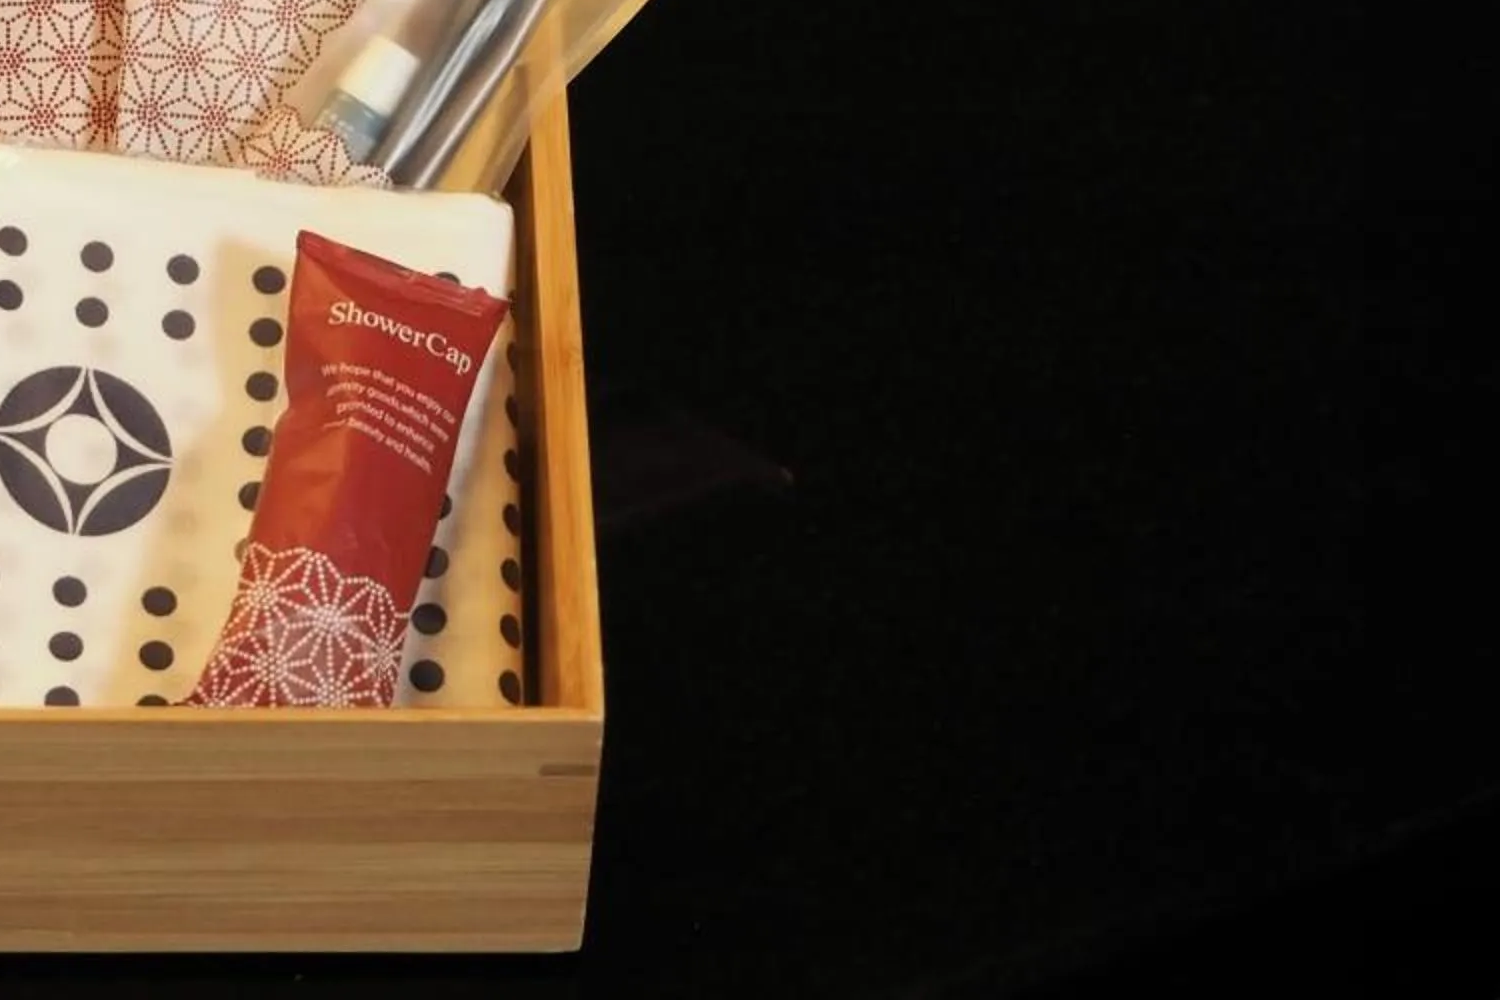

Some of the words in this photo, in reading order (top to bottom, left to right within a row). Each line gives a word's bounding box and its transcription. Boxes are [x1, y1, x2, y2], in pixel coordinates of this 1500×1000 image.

[328, 301, 472, 375] ShowerCap
[372, 368, 395, 387] that
[395, 380, 415, 398] you
[384, 413, 396, 427] to
[385, 436, 405, 454] and
